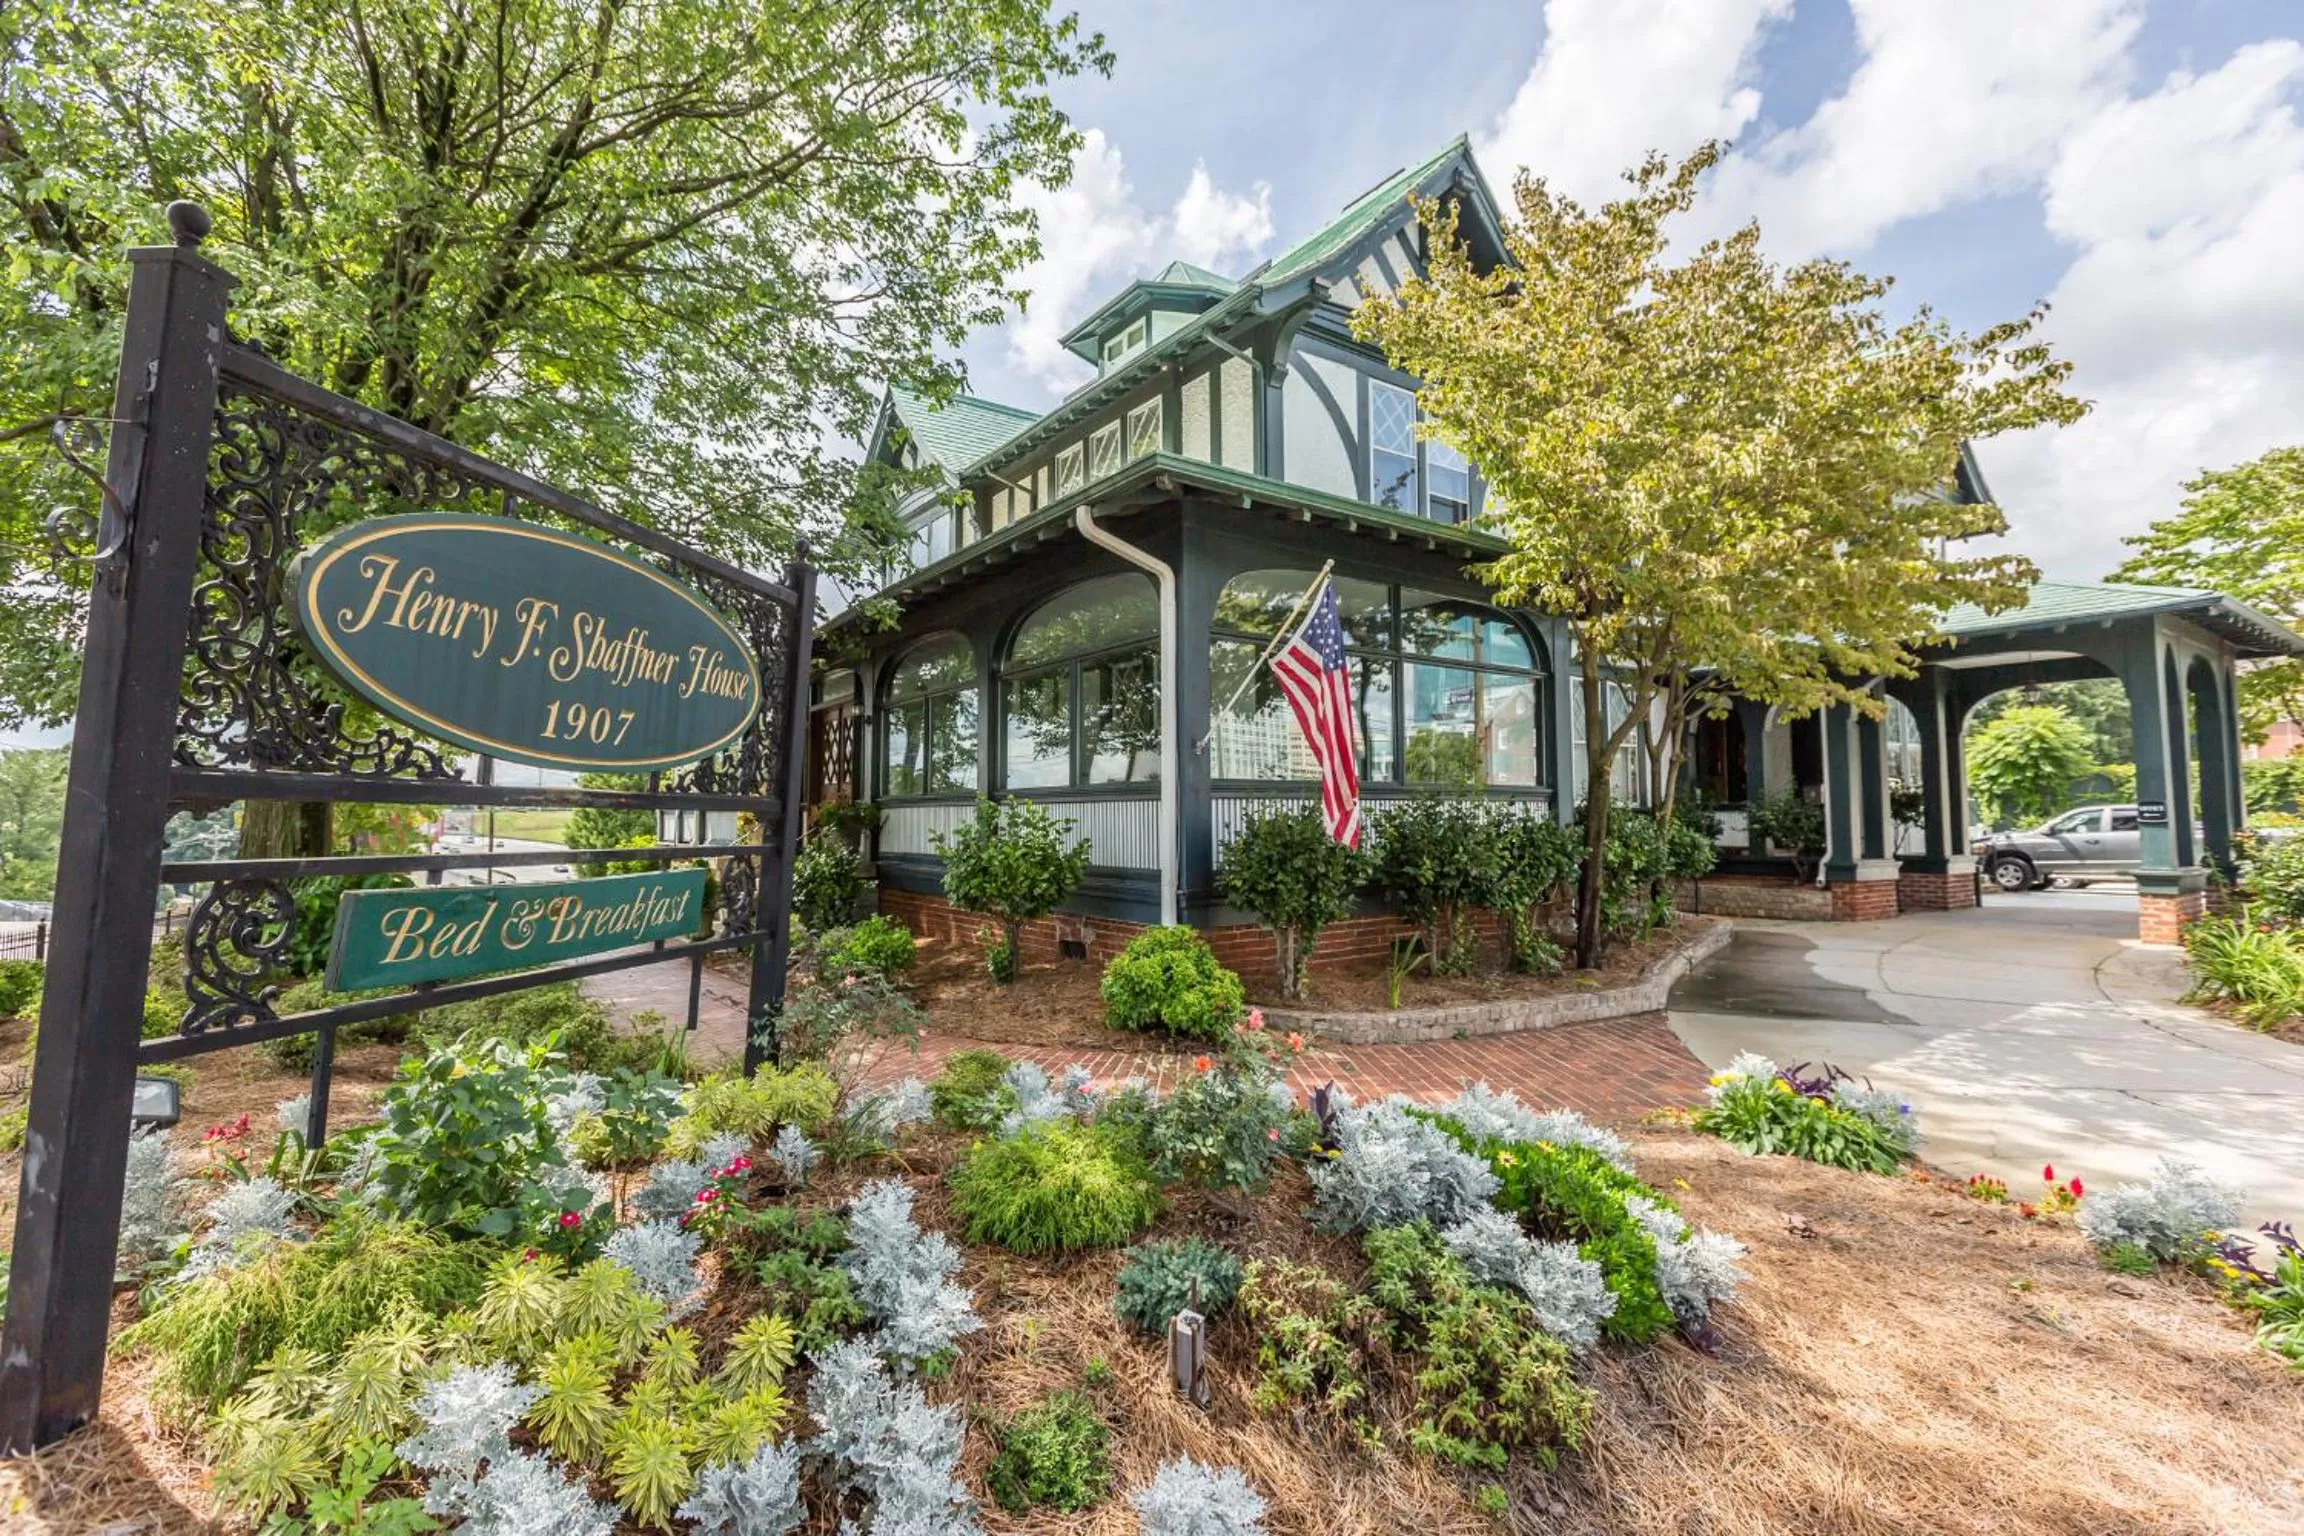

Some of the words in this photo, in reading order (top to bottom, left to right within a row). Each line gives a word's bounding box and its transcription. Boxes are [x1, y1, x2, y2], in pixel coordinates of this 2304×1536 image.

[337, 553, 499, 658] Henry
[500, 597, 558, 667] F.
[549, 611, 680, 686] Shaffner
[678, 645, 749, 700] House
[540, 699, 635, 747] 1907
[379, 901, 499, 965] Bed
[501, 899, 545, 950] &
[545, 886, 692, 945] Breakfast
